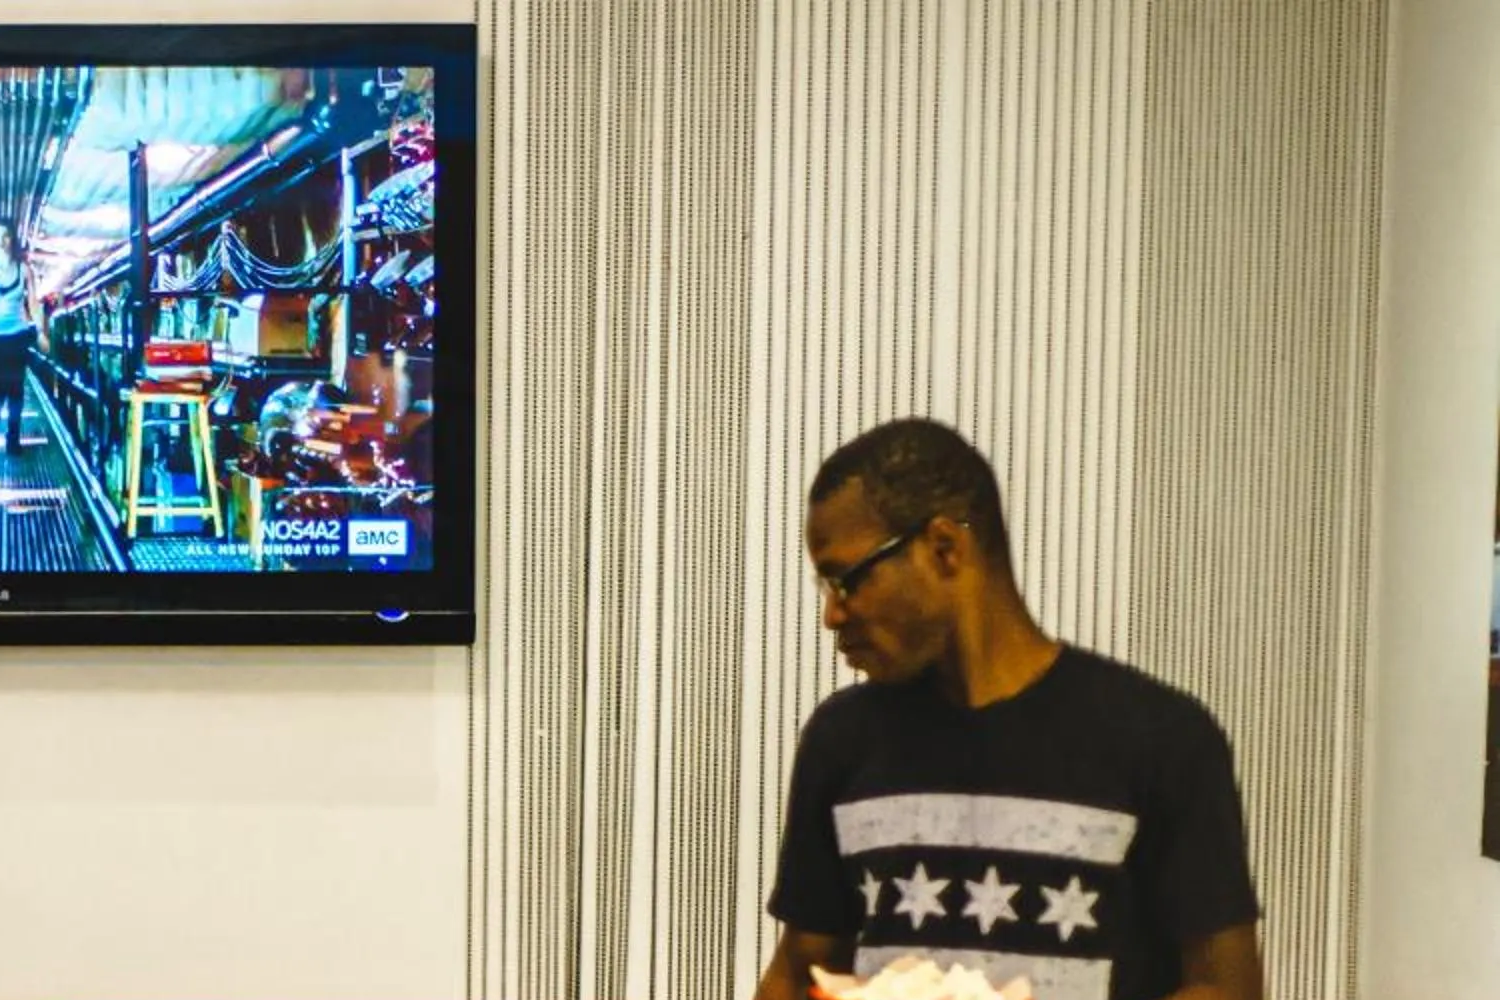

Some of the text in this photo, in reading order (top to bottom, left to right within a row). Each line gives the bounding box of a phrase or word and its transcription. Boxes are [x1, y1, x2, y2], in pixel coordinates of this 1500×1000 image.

[262, 520, 340, 540] NOS4A2
[186, 544, 340, 555] ALL NEW UNDAY 10P
